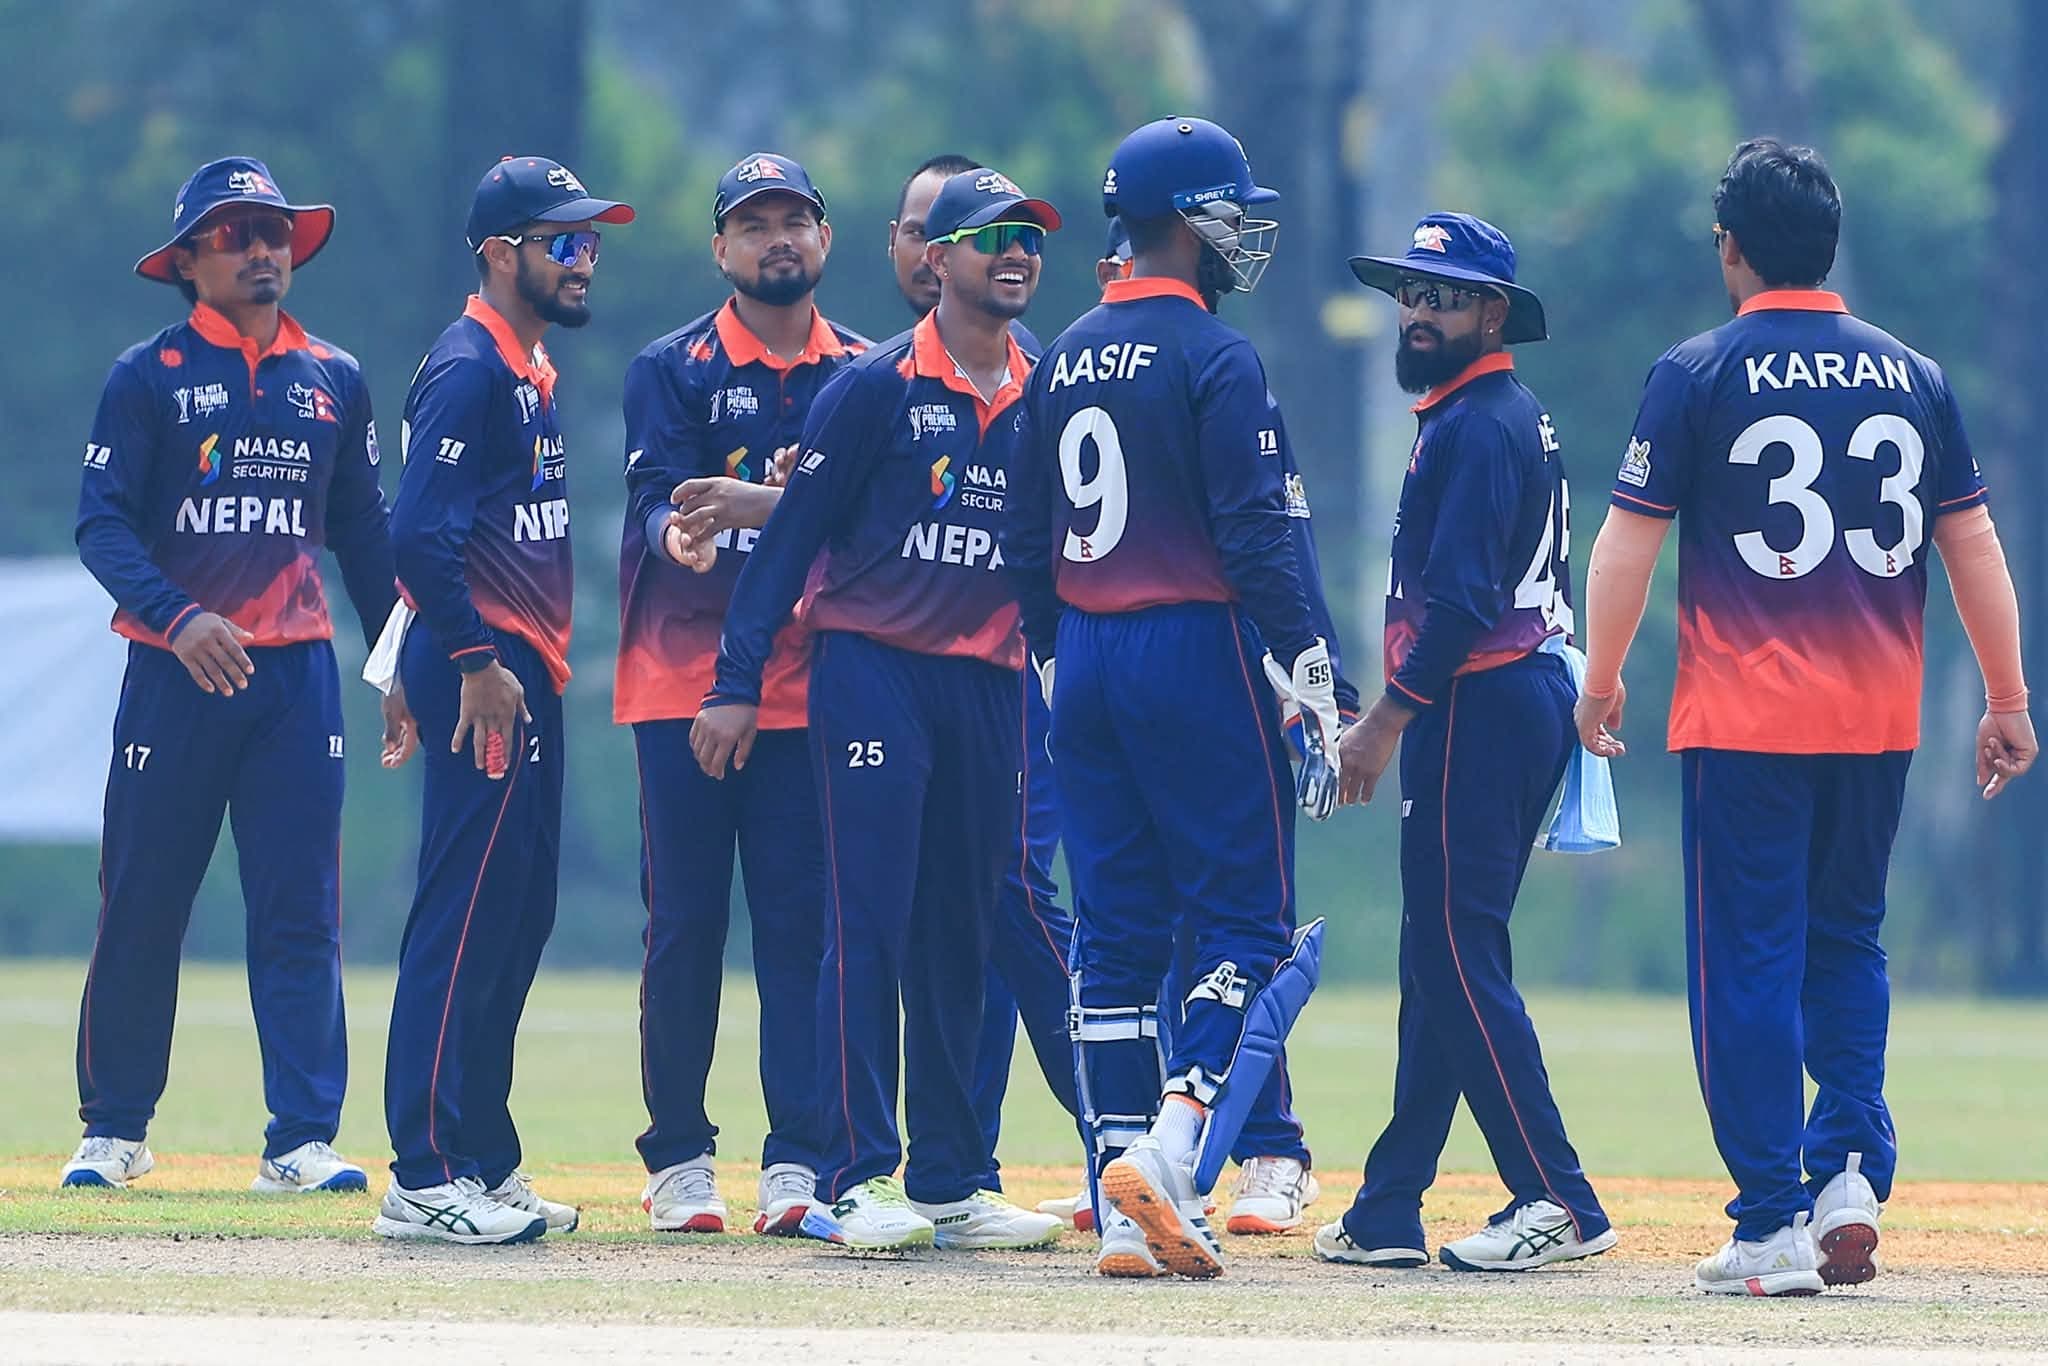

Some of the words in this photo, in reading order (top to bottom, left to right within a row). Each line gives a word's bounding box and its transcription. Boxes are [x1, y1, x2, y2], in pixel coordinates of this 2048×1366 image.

[1194, 189, 1225, 202] SHREY
[1049, 343, 1158, 392] AASIF
[1745, 352, 1912, 394] KARAN
[234, 437, 312, 462] NAASA
[232, 464, 308, 483] SECURITIES
[1058, 406, 1128, 563] 9
[1728, 414, 1925, 580] 33
[175, 496, 307, 538] NEPAL
[1308, 664, 1329, 685] SS
[124, 743, 151, 771] 17
[529, 736, 540, 762] 2
[847, 741, 885, 768] 25
[934, 1212, 971, 1226] LOTTO
